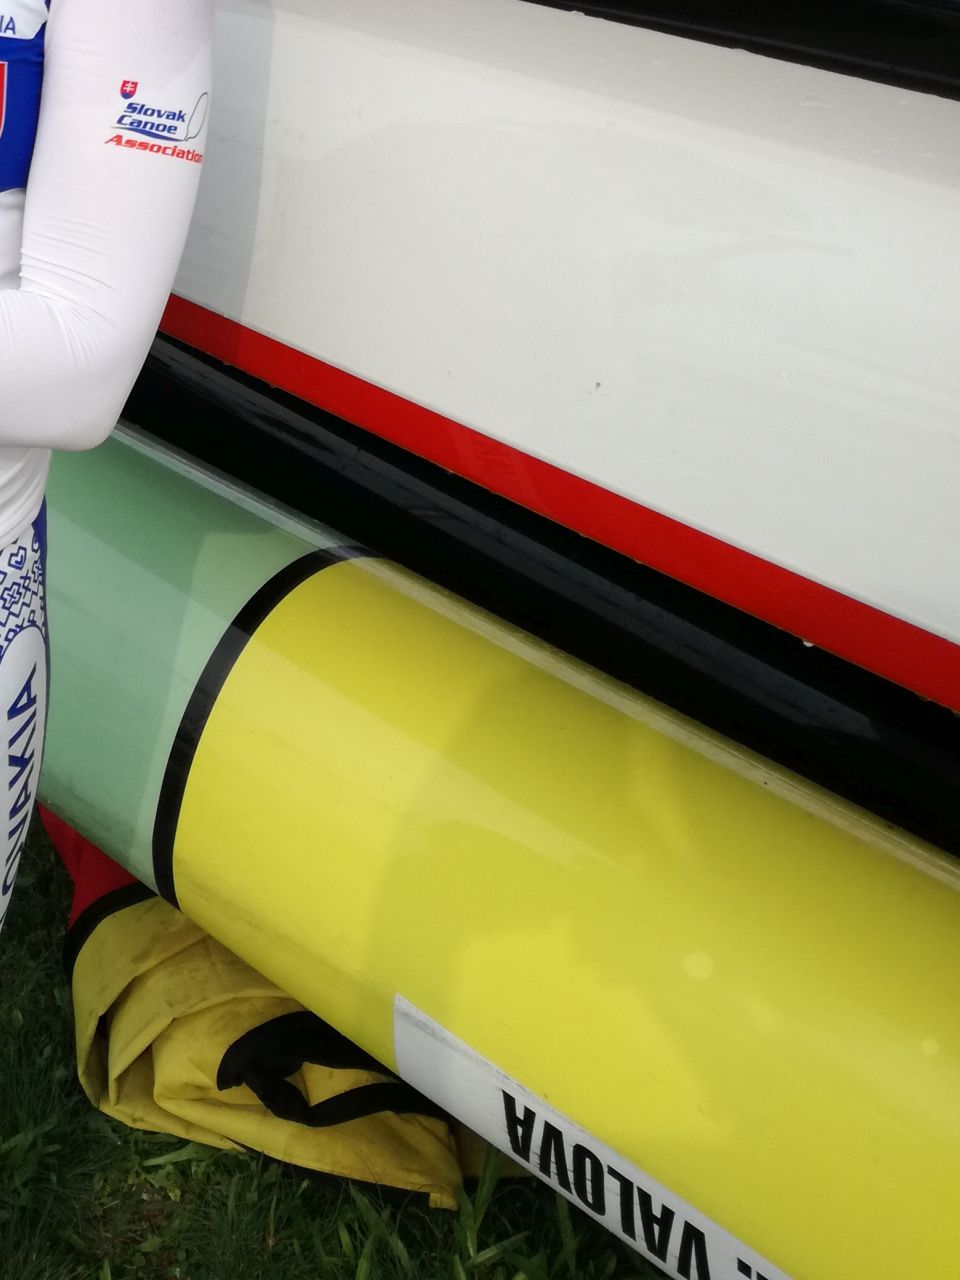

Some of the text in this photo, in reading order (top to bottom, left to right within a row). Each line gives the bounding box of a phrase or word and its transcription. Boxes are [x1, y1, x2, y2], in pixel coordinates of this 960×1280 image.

[117, 114, 178, 134] Canoe
[123, 102, 186, 122] Slovak
[104, 134, 203, 163] Associatio
[501, 1089, 711, 1280] VALOVA
